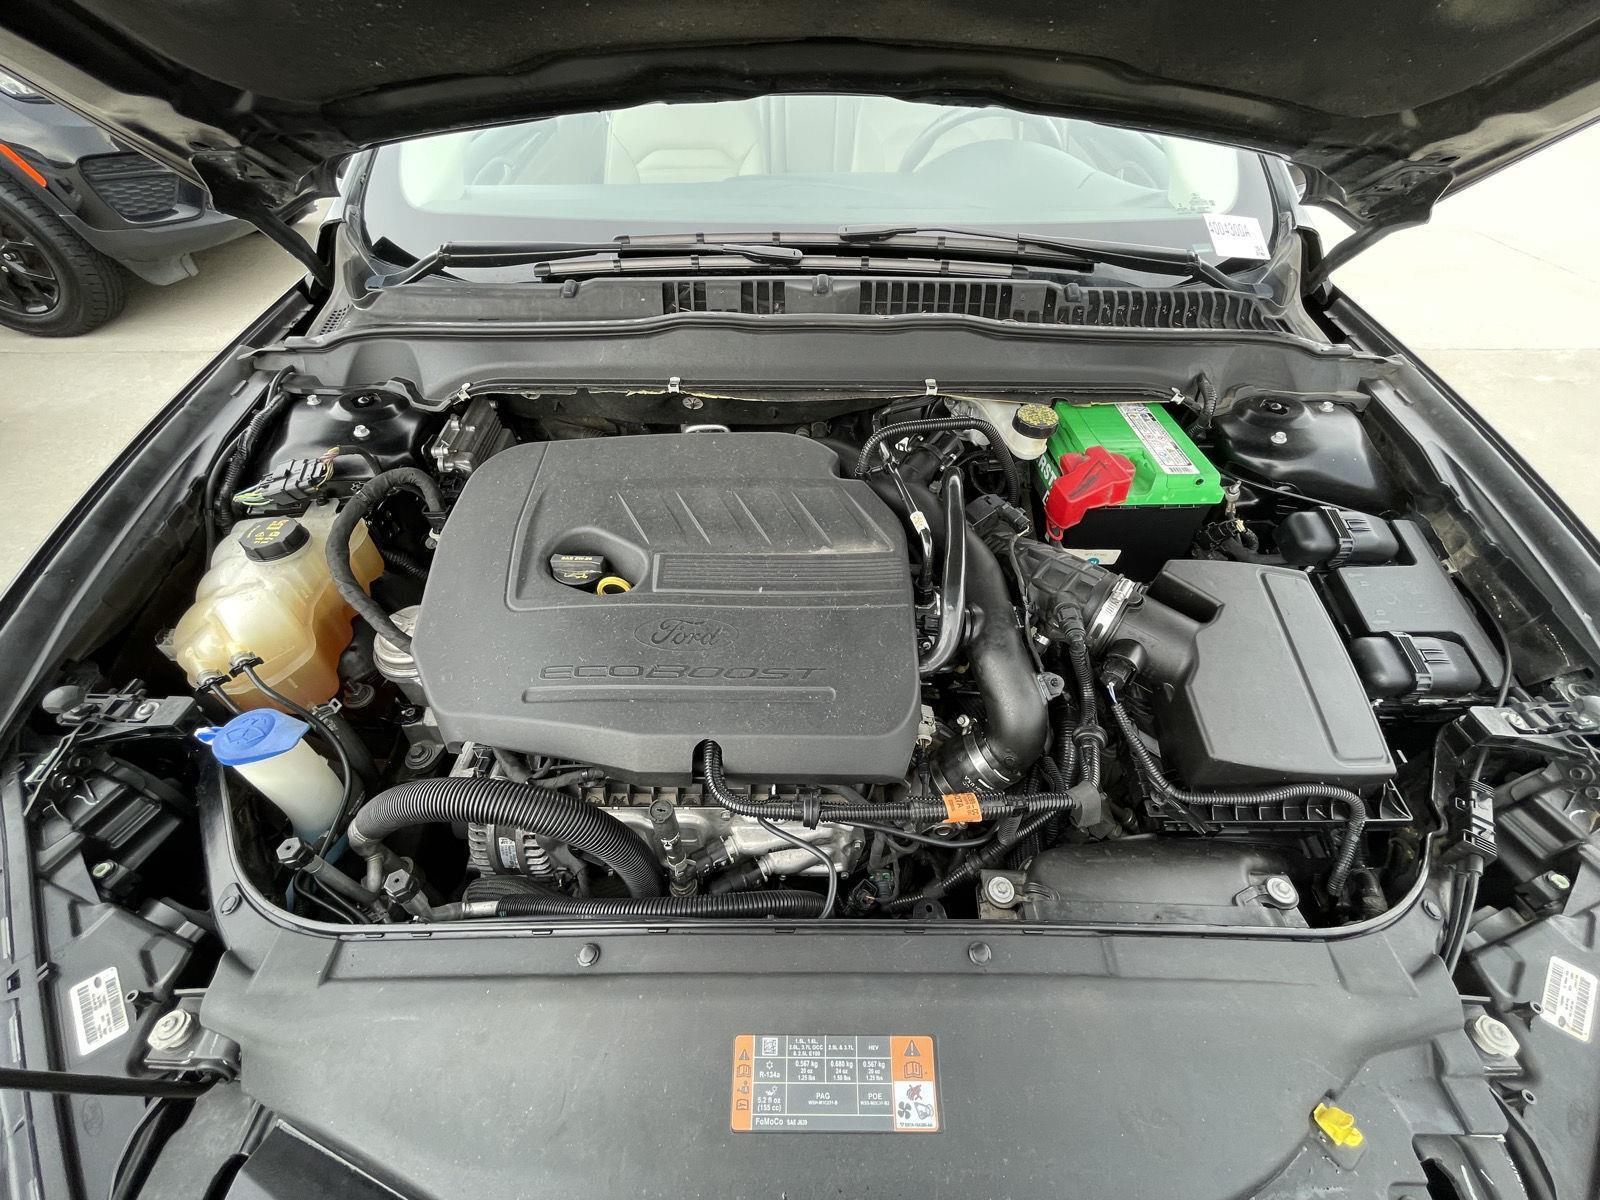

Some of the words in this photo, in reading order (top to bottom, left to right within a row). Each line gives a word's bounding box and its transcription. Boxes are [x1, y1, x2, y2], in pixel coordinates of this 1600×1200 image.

[650, 618, 723, 647] Ford
[539, 664, 827, 681] ECOBOOST
[810, 1060, 818, 1068] kg
[846, 1060, 853, 1068] kg
[878, 1061, 885, 1069] kg
[755, 1117, 783, 1125] FoMoCo
